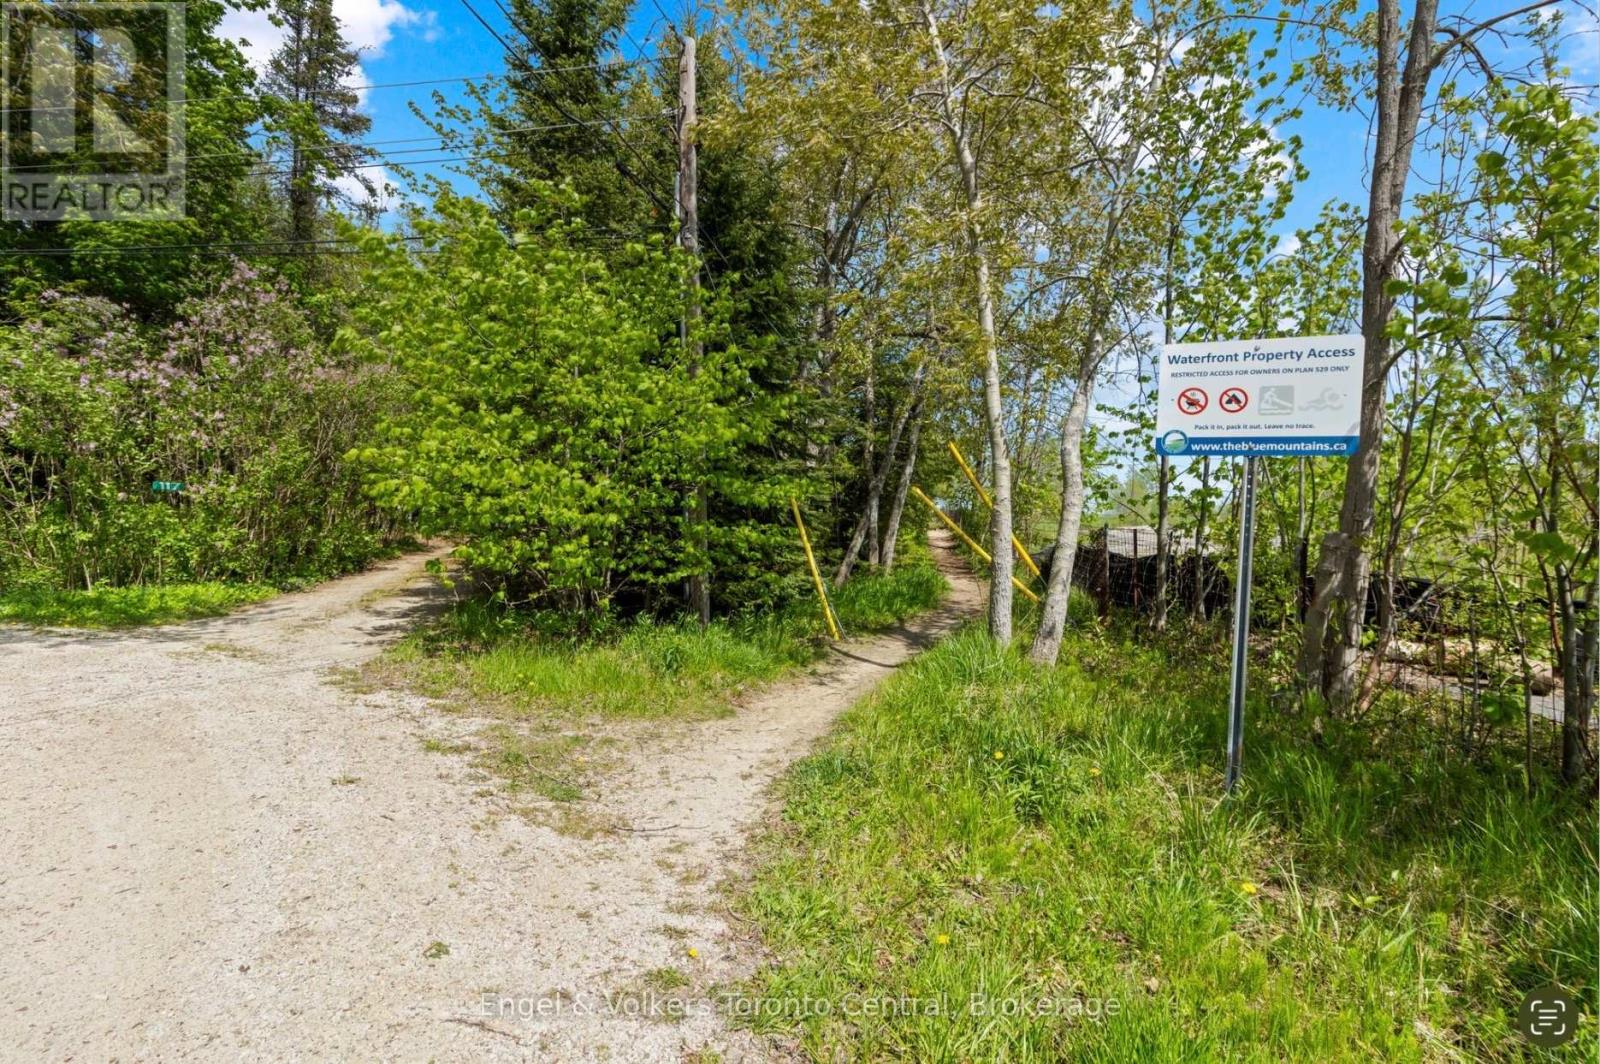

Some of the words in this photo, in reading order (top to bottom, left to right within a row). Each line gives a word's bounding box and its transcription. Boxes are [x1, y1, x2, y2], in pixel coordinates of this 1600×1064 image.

[1168, 352, 1239, 365] Waterfront
[1243, 349, 1303, 363] Property
[1307, 347, 1356, 359] Access
[1209, 369, 1234, 377] ACCESS
[1250, 367, 1280, 375] OWNERS
[1294, 366, 1314, 374] PLAN
[1226, 424, 1241, 432] pack
